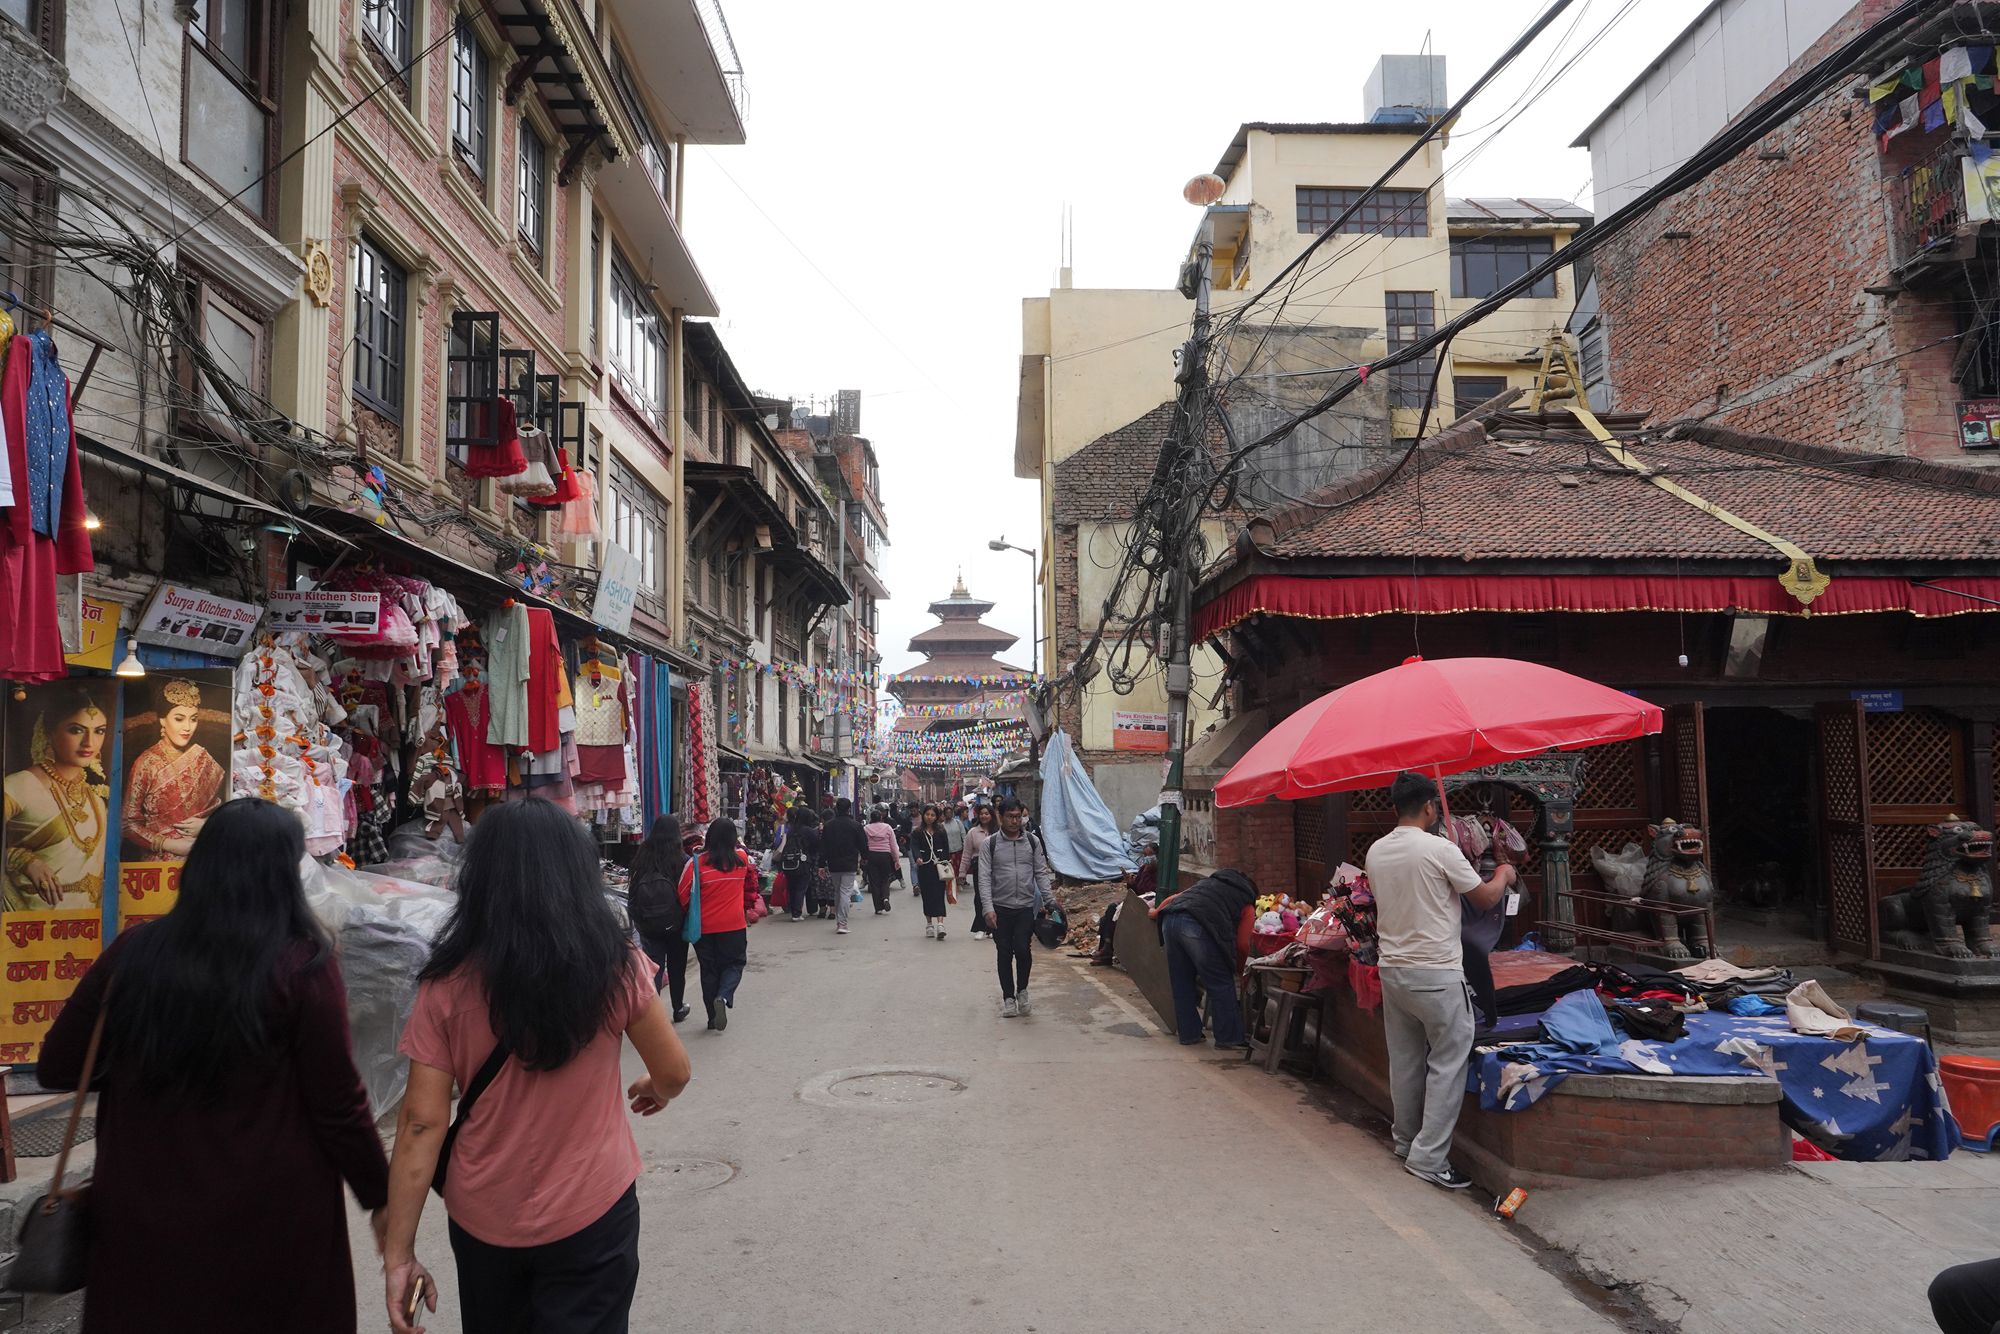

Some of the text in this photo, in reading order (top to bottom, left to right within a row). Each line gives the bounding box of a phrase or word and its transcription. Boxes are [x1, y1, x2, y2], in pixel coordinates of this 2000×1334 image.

[270, 591, 378, 602] Surya Kitchen Store
[604, 578, 633, 606] ASHVIK
[164, 591, 195, 611] Surya
[195, 599, 235, 618] Kitchen
[232, 608, 257, 624] Store
[122, 868, 162, 900] सुन
[6, 920, 46, 948] सुन
[51, 918, 100, 941] भन्दा
[6, 960, 50, 982] कम
